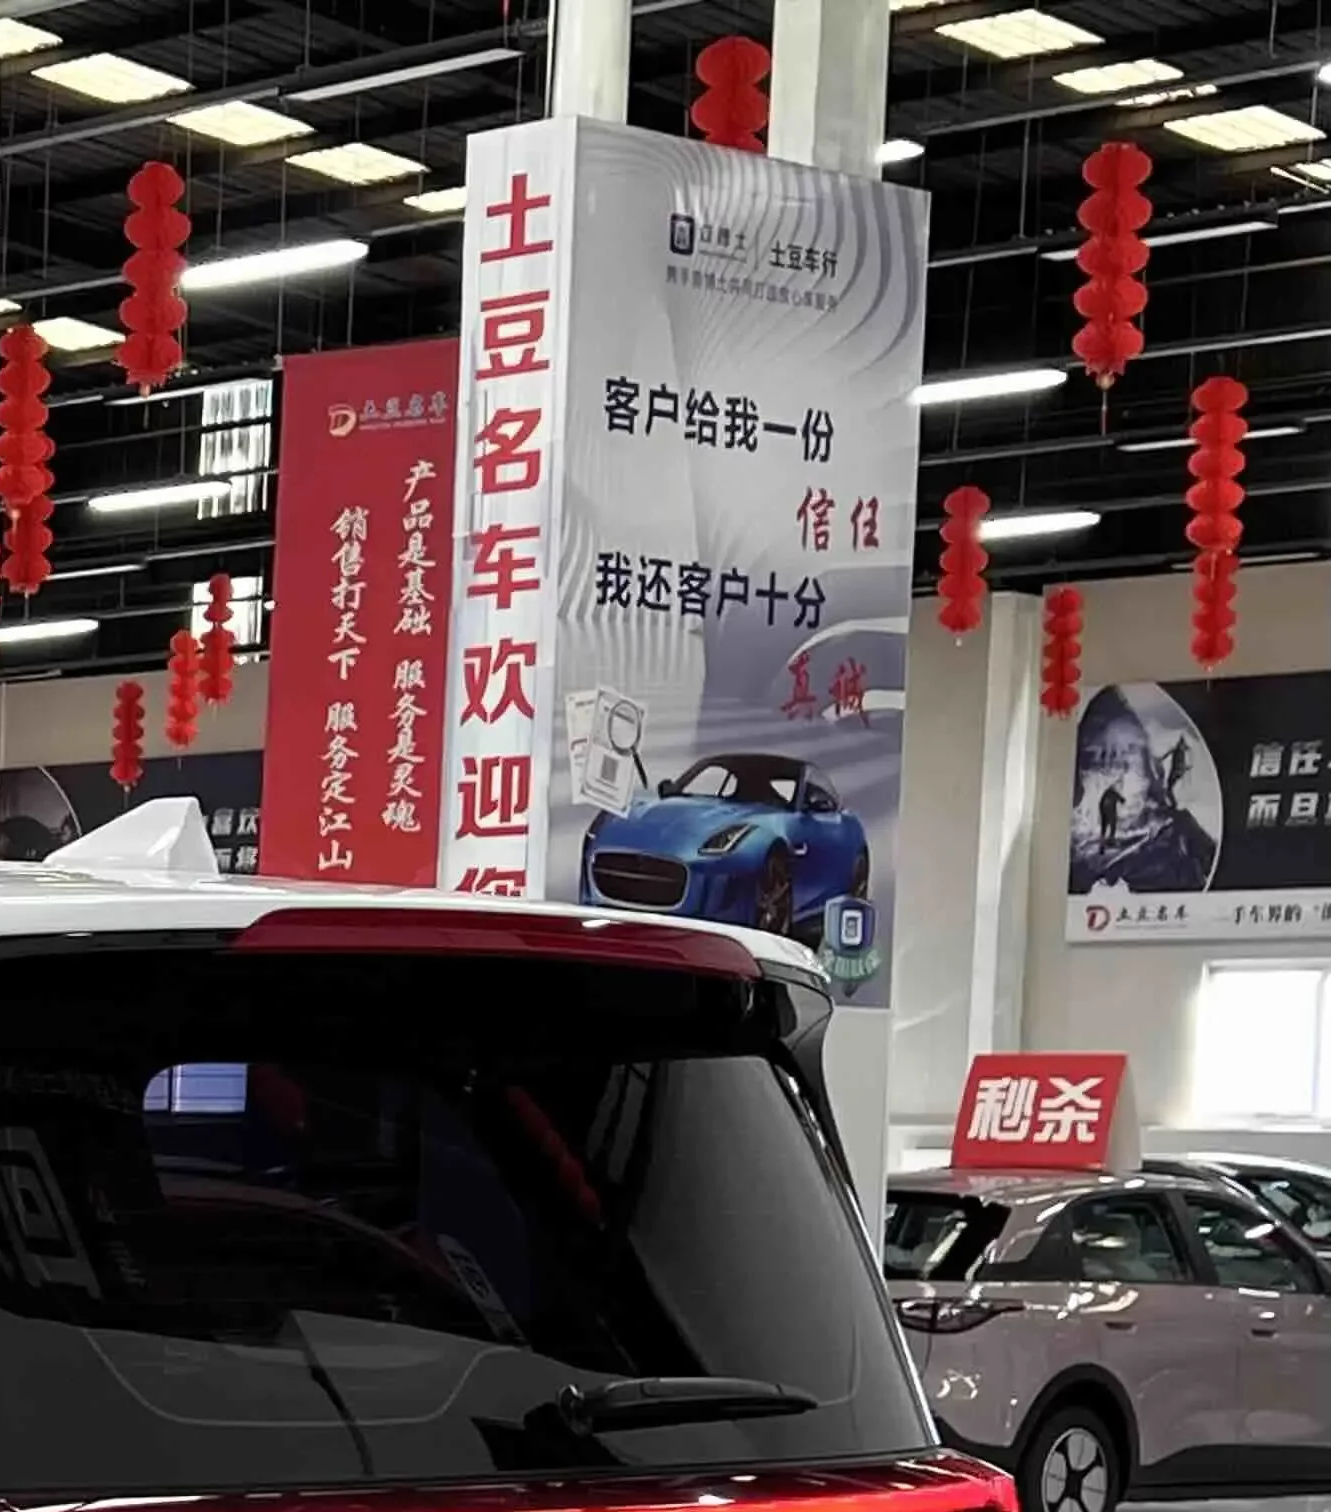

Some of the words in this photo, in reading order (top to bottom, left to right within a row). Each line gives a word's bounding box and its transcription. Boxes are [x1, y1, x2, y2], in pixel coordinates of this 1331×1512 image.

[770, 240, 838, 278] 土豆车行
[604, 376, 834, 462] 客户给我一份
[394, 460, 436, 635] 产品是基础
[796, 486, 880, 551] 信任
[596, 551, 826, 629] 我还客户十分
[780, 650, 871, 729] 真诚
[381, 659, 428, 833] 服务是灵魂
[1249, 739, 1331, 779] 信任
[318, 701, 359, 872] 服务定江山
[1246, 792, 1331, 828] 而且
[968, 1075, 1105, 1144] 秒杀
